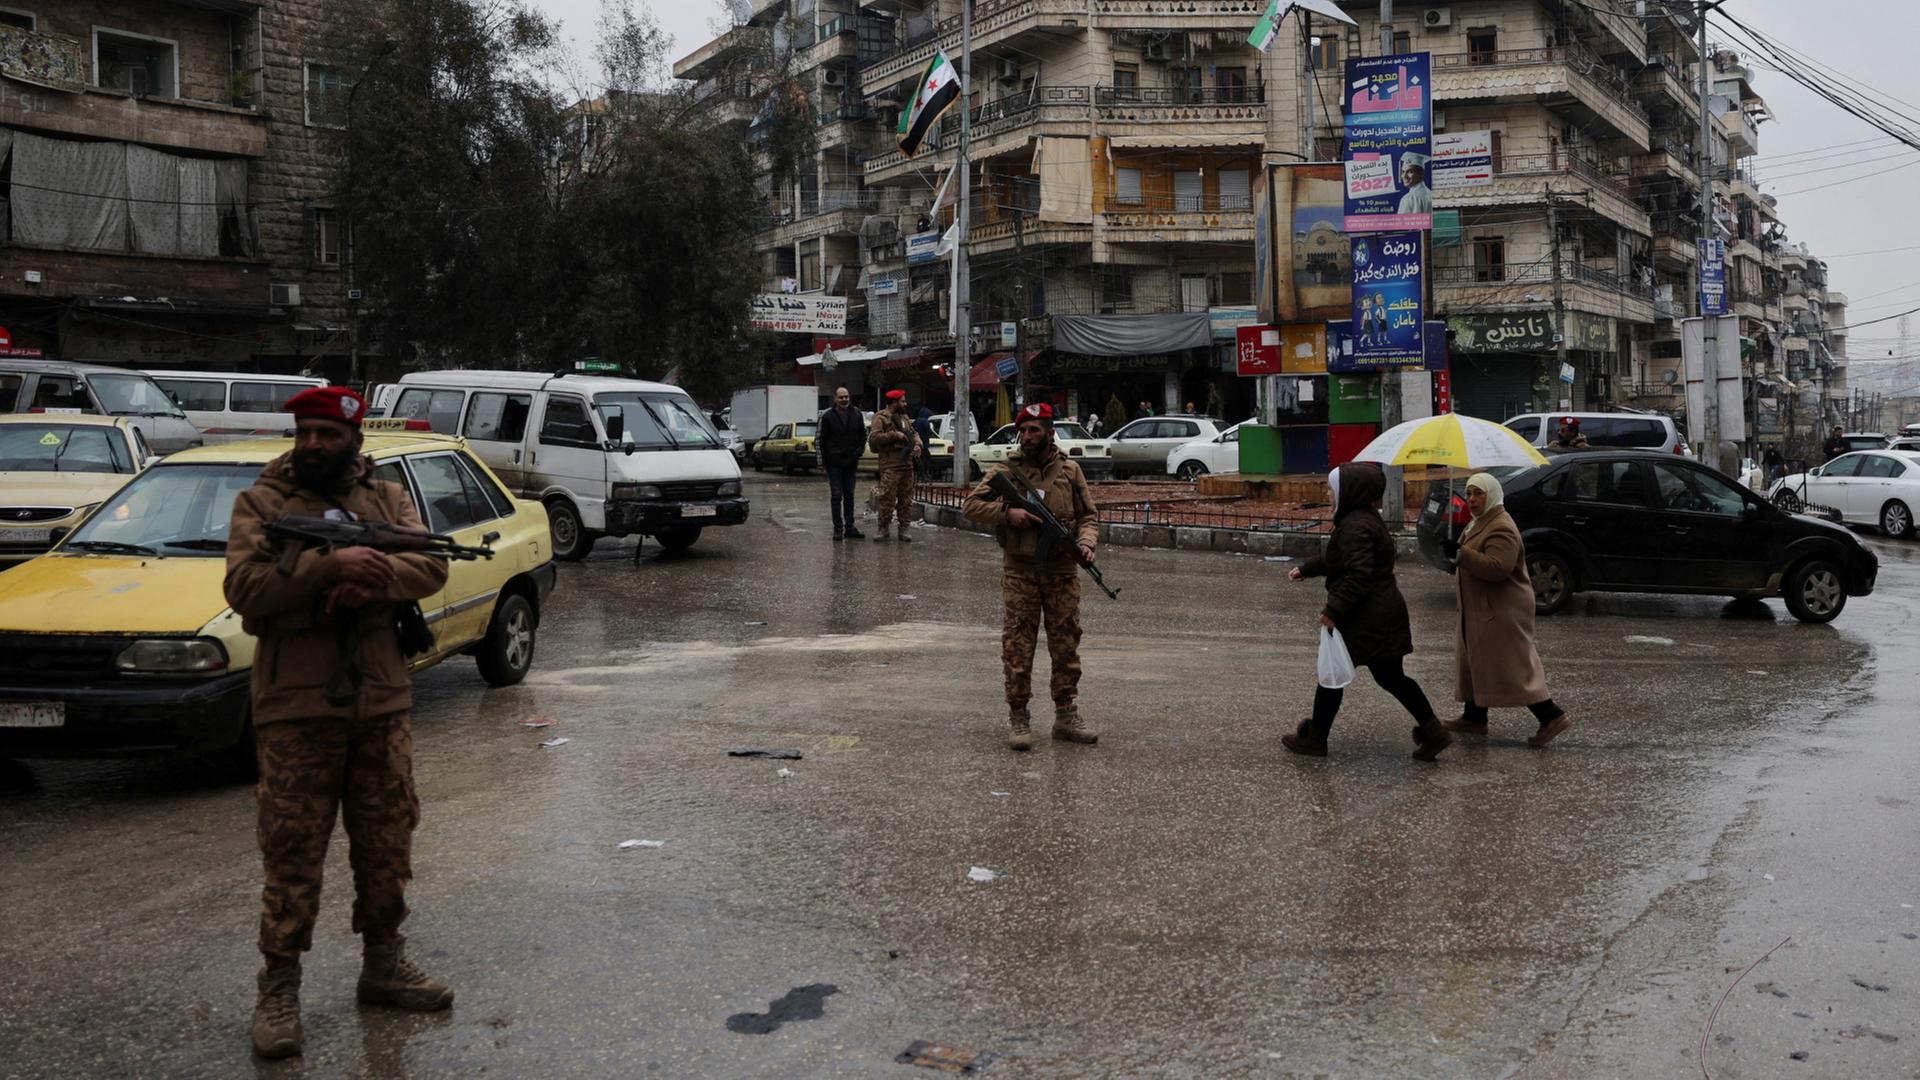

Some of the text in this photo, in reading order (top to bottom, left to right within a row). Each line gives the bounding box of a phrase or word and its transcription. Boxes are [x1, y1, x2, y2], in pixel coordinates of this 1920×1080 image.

[1372, 72, 1398, 83] معهد
[1352, 125, 1424, 138] افتتاح التسجيل لدورات
[1402, 137, 1427, 148] العلمي
[1351, 160, 1388, 174] بدء التسجيل
[1351, 176, 1392, 193] 2027
[1383, 240, 1416, 256] روضة
[1402, 261, 1420, 280] قطر
[816, 301, 845, 314] Syrian
